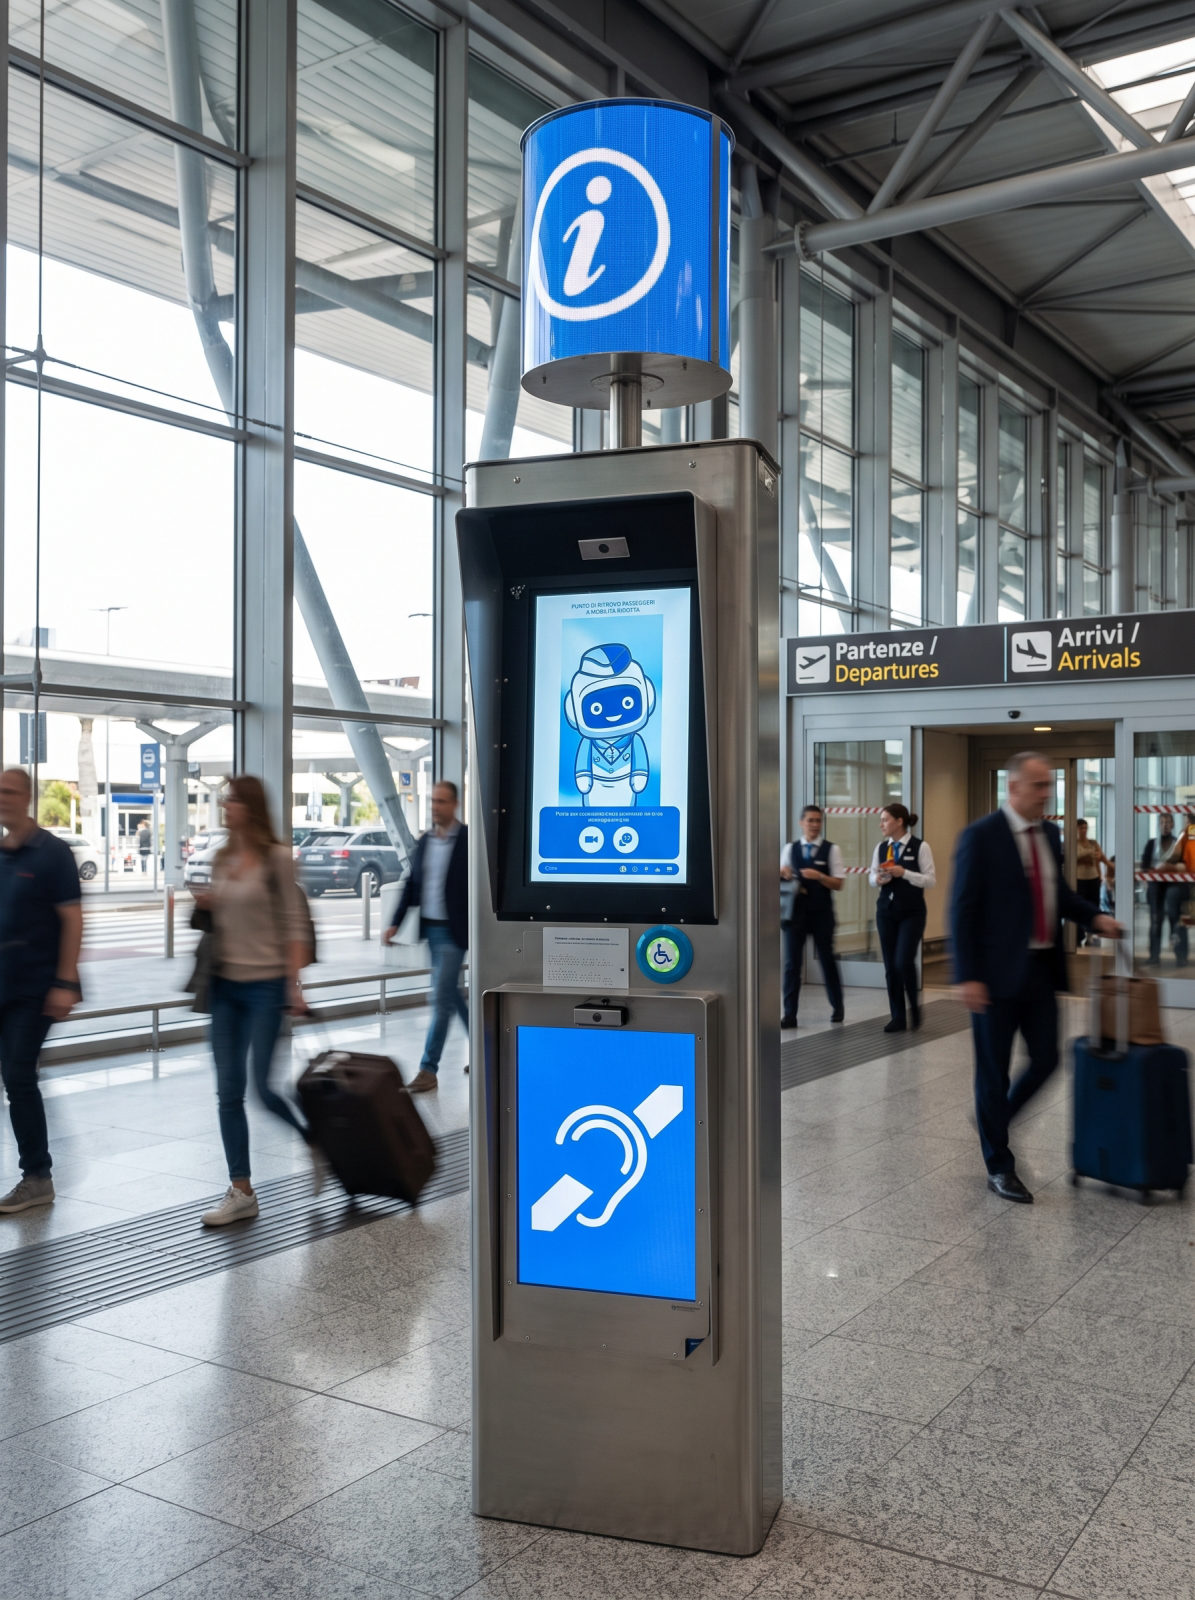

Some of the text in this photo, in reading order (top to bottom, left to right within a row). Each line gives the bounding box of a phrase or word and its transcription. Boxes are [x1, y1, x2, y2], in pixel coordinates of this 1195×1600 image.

[1057, 621, 1140, 648] Arrivi /
[835, 635, 938, 661] Partenze /
[1057, 646, 1141, 671] Arrivals
[835, 662, 939, 686] Departures
